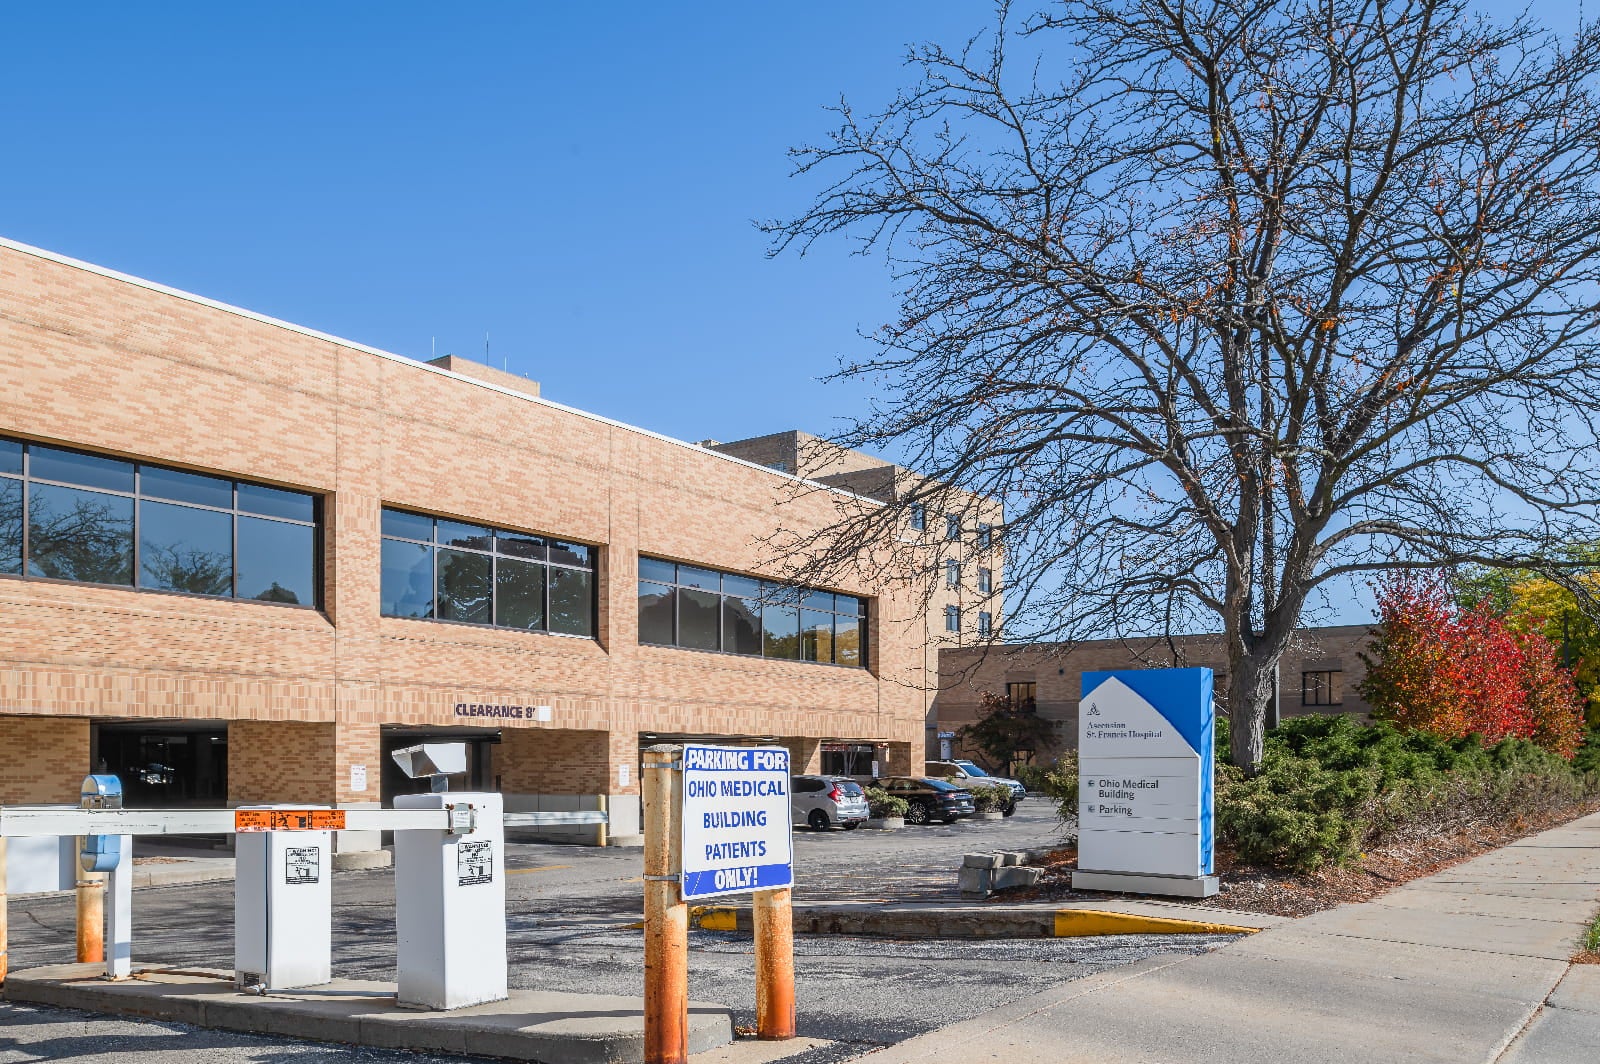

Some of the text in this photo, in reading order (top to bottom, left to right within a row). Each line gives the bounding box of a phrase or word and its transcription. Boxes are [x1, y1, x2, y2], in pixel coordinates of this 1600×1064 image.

[455, 703, 536, 719] CLEARANCE 8'
[1087, 721, 1126, 729] Ascension
[1086, 730, 1162, 740] St. Francis Hospital
[687, 749, 786, 770] PARKING FOR
[688, 780, 786, 798] OHIO MEDICAL
[1098, 779, 1159, 789] Ohio Medical
[1098, 789, 1135, 801] Building
[1099, 804, 1133, 816] Parking
[703, 811, 767, 829] BUILDING
[705, 840, 767, 861] PATIENTS
[714, 867, 758, 890] ONLY!
